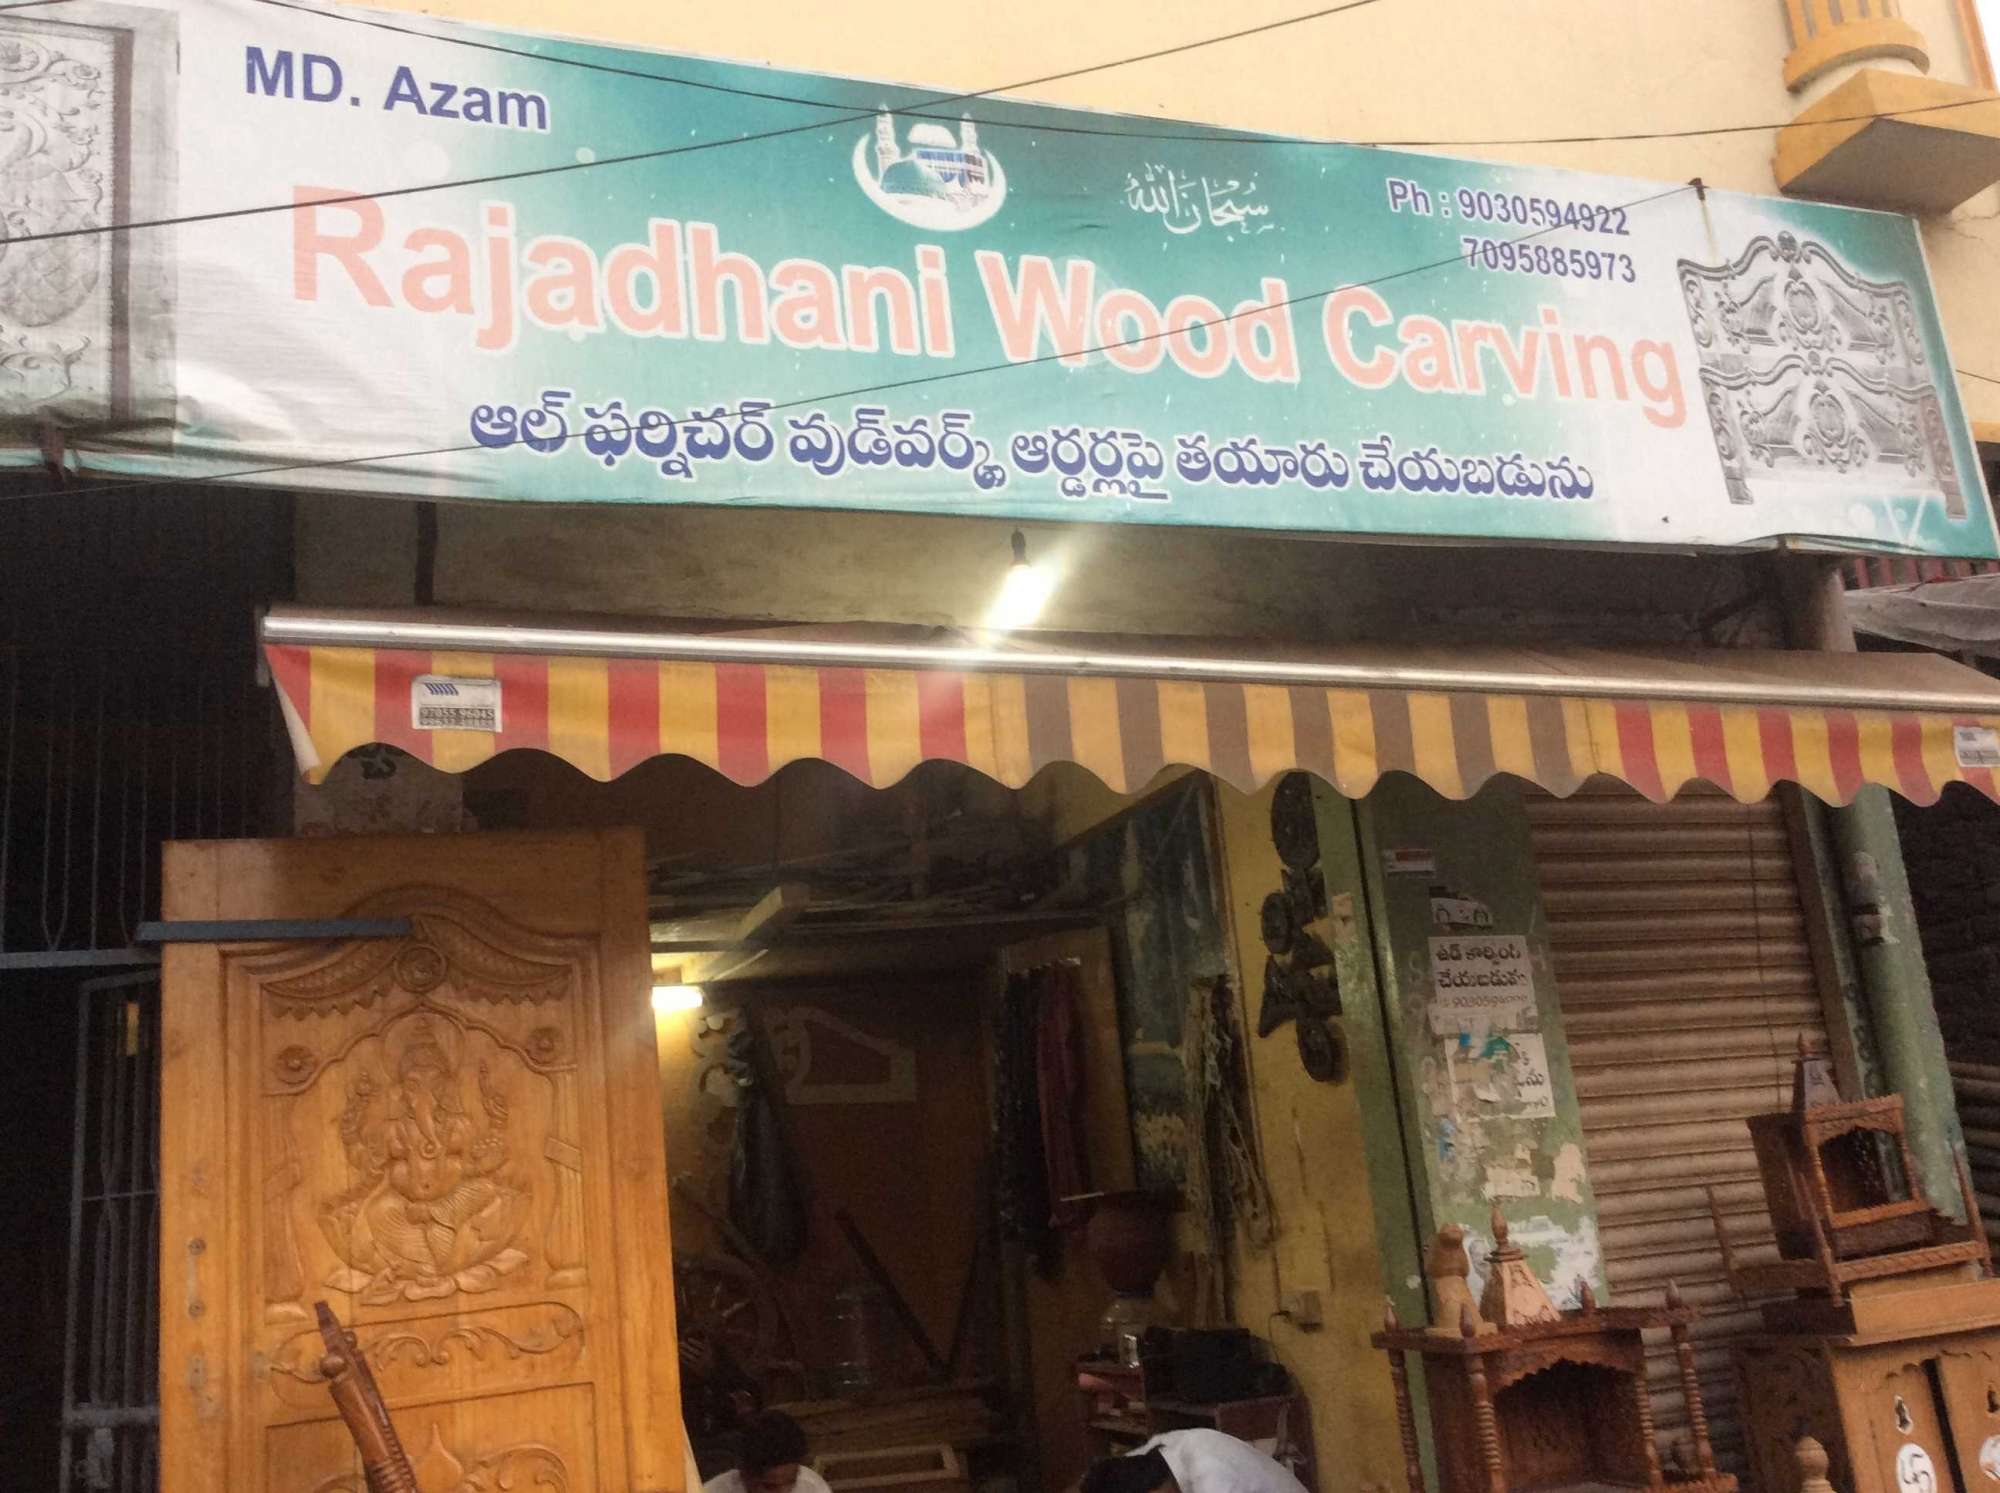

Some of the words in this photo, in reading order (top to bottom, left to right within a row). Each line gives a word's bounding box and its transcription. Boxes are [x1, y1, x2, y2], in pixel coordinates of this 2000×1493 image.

[245, 46, 360, 107] MD.
[383, 65, 548, 130] Azam
[1388, 180, 1431, 214] Ph
[1458, 188, 1631, 237] 9030594922
[1462, 238, 1637, 283] 7095885973
[292, 185, 954, 357] Rajadhani
[979, 250, 1297, 379] Wood
[1326, 285, 1688, 428] Carving
[470, 390, 571, 453] ఆల్
[584, 401, 775, 479] ఫర్నిచర్
[1011, 428, 1169, 499] ఆర్డర్లపై
[1176, 434, 1350, 488] తయారు
[1358, 435, 1594, 499] చేయబడును
